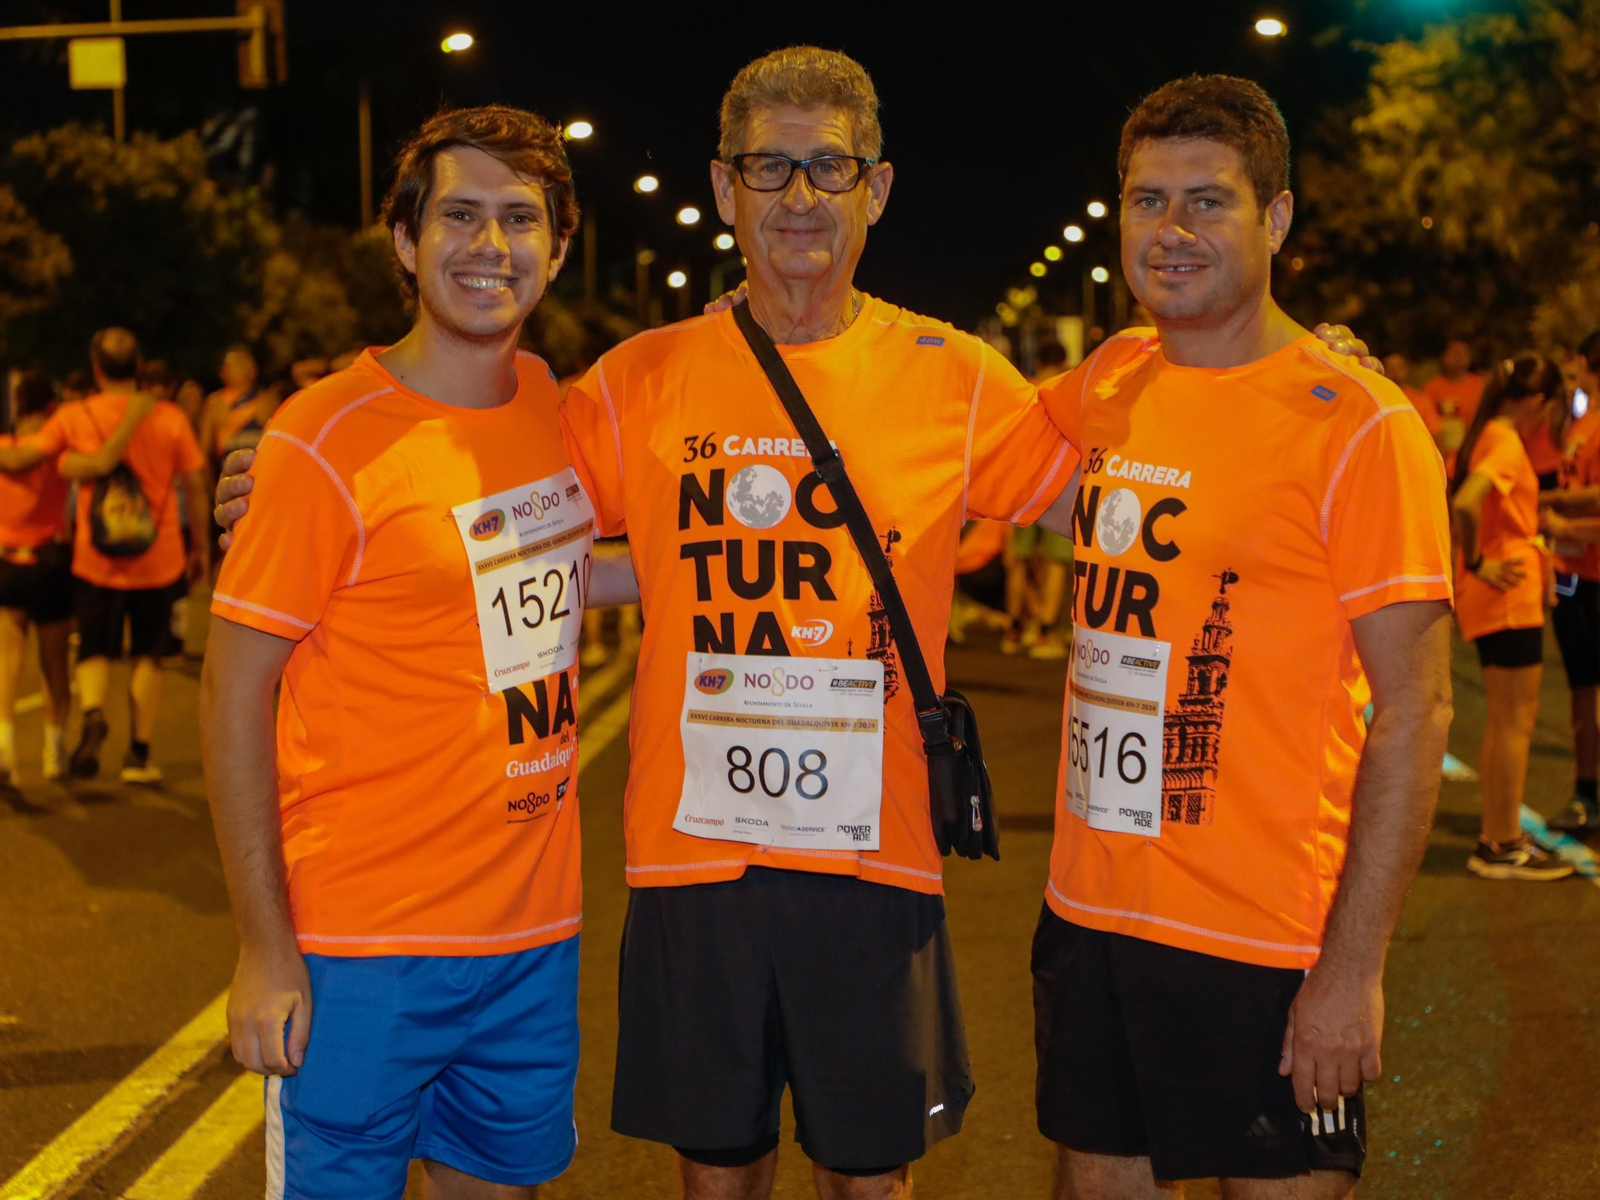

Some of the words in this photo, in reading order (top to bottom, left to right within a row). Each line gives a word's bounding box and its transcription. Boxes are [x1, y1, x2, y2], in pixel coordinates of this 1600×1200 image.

[683, 432, 717, 463] 36
[723, 435, 838, 457] CARRE
[1083, 447, 1108, 474] 36
[1106, 454, 1192, 489] CARRERA
[494, 553, 517, 566] CARRERA
[517, 544, 543, 557] NOCTURNA
[543, 541, 552, 549] DEL
[680, 539, 838, 601] TUR
[492, 552, 590, 637] 15210
[693, 611, 792, 657] NA
[494, 661, 531, 677] Cruzcampo
[502, 671, 575, 745] NA
[1141, 703, 1156, 711] 2024
[709, 714, 734, 723] CARRERA
[735, 717, 771, 725] NOCTURNA
[787, 719, 839, 728] GUADALQUIVIR
[726, 745, 829, 800] 808
[685, 814, 725, 827] Cruzcampo
[1119, 807, 1153, 819] POWER
[1134, 818, 1153, 828] ADE
[837, 825, 871, 834] POWER
